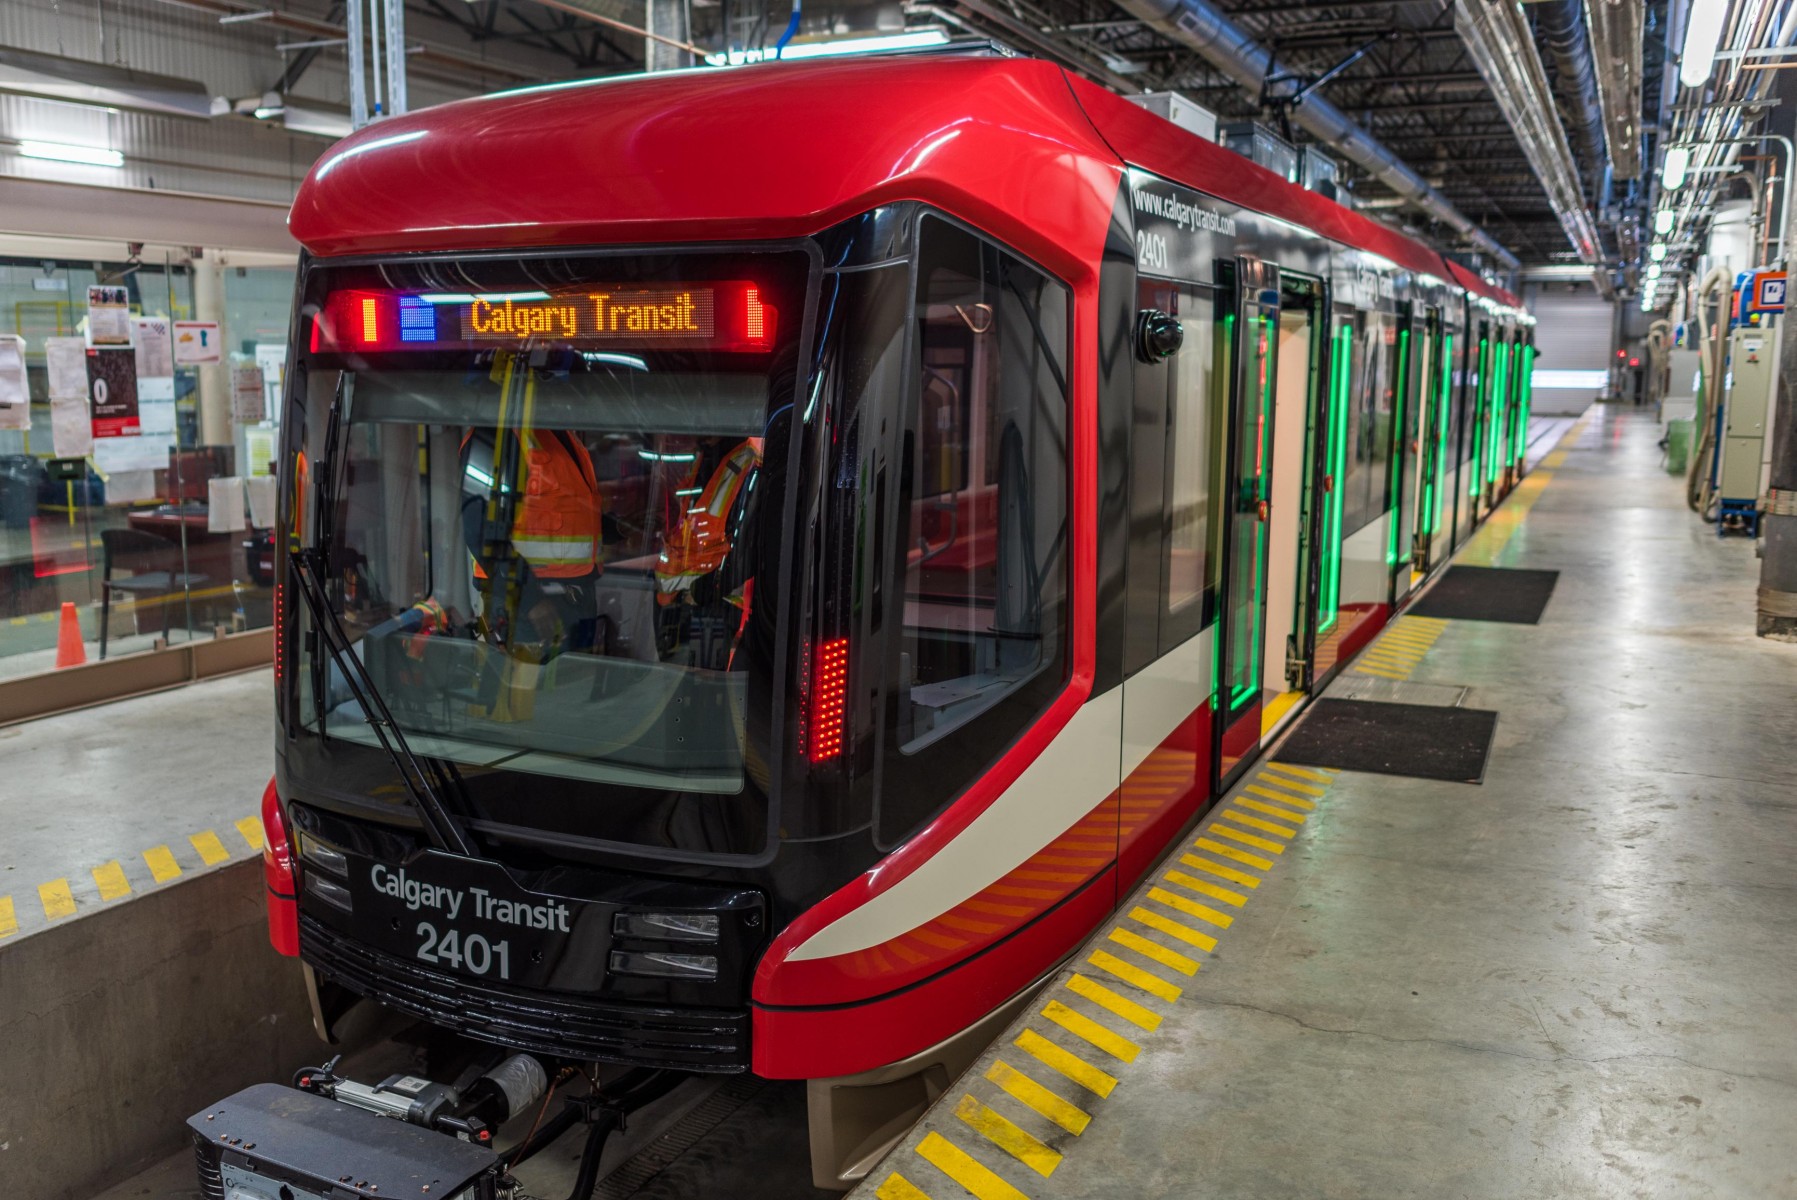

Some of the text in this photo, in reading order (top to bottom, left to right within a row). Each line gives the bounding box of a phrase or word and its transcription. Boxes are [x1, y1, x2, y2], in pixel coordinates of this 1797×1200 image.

[1133, 188, 1236, 237] www.calgarytransit.com
[1138, 229, 1168, 269] 2401
[471, 292, 698, 337] Calgary Transit
[371, 864, 570, 933] Calgary Transit
[416, 921, 509, 980] 2401
